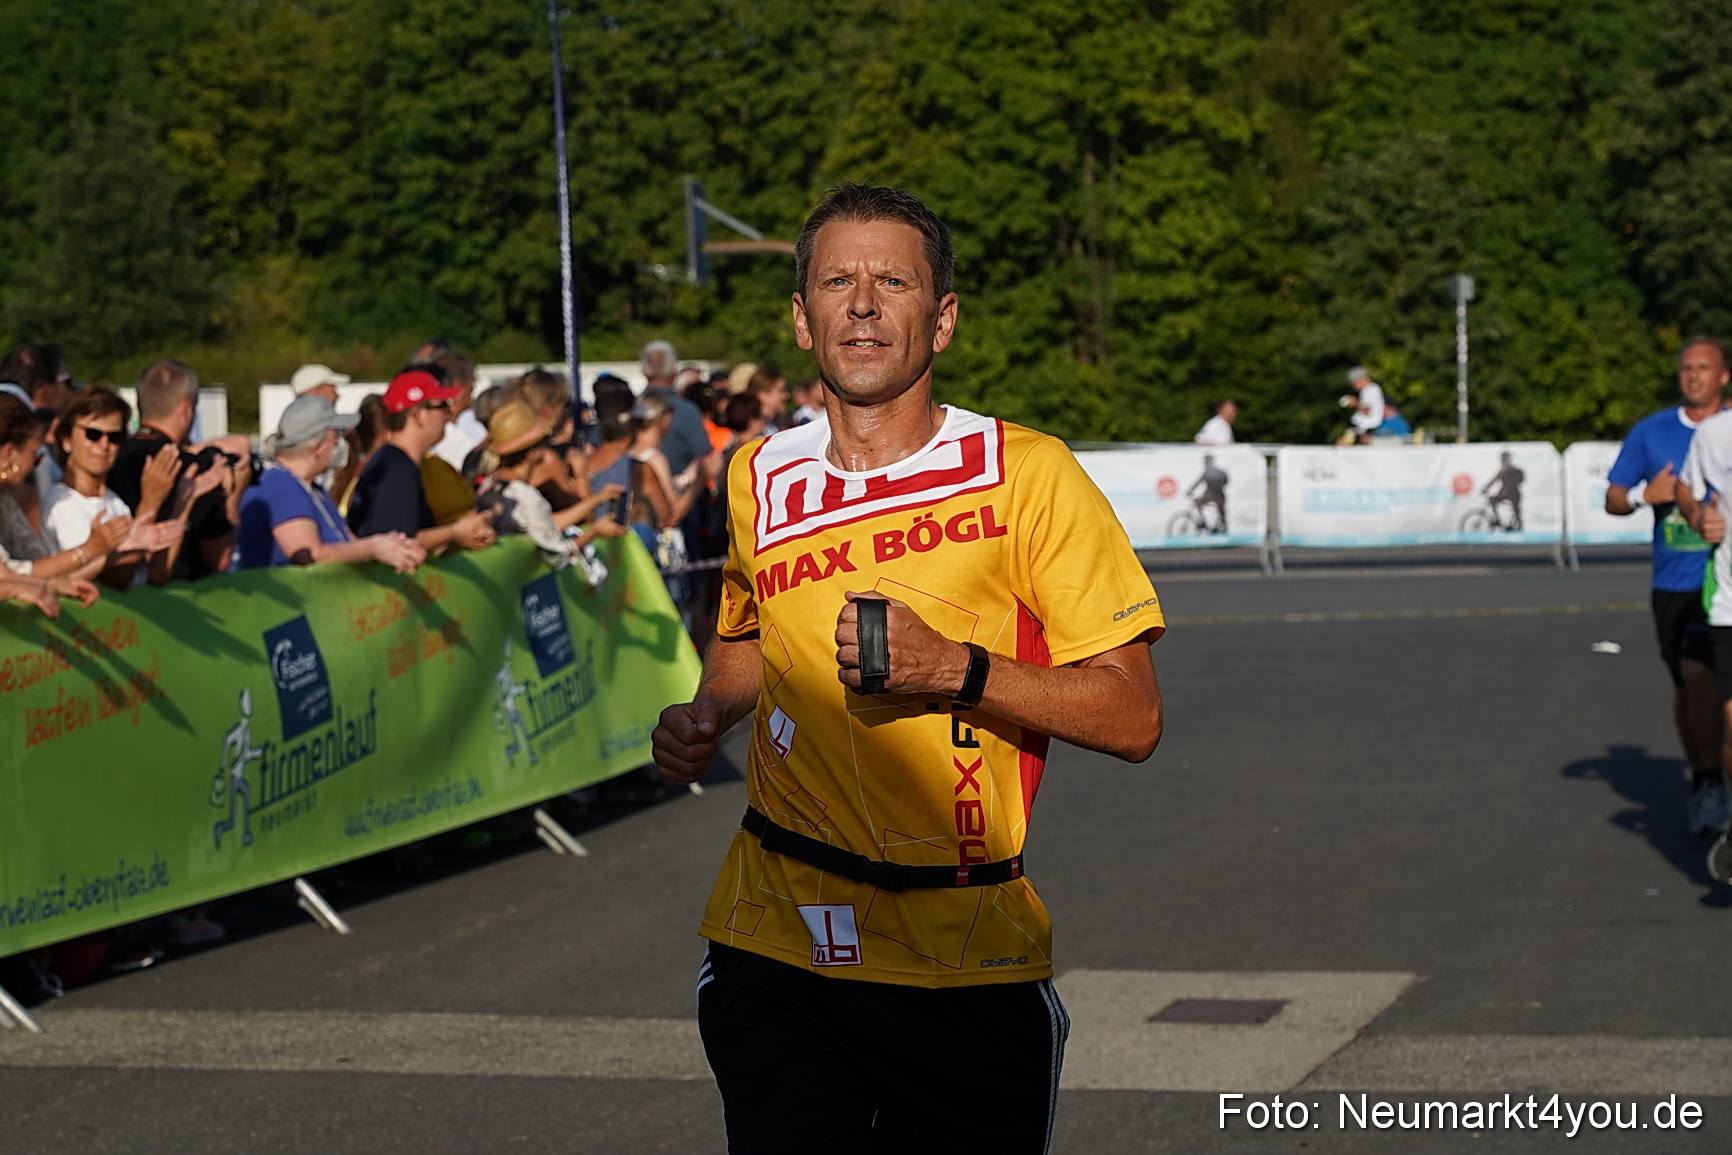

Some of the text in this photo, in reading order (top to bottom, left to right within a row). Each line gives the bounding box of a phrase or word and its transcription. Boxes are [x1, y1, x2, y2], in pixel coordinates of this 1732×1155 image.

[755, 505, 1009, 605] MAX BÖGL
[257, 687, 378, 809] firmenlauf
